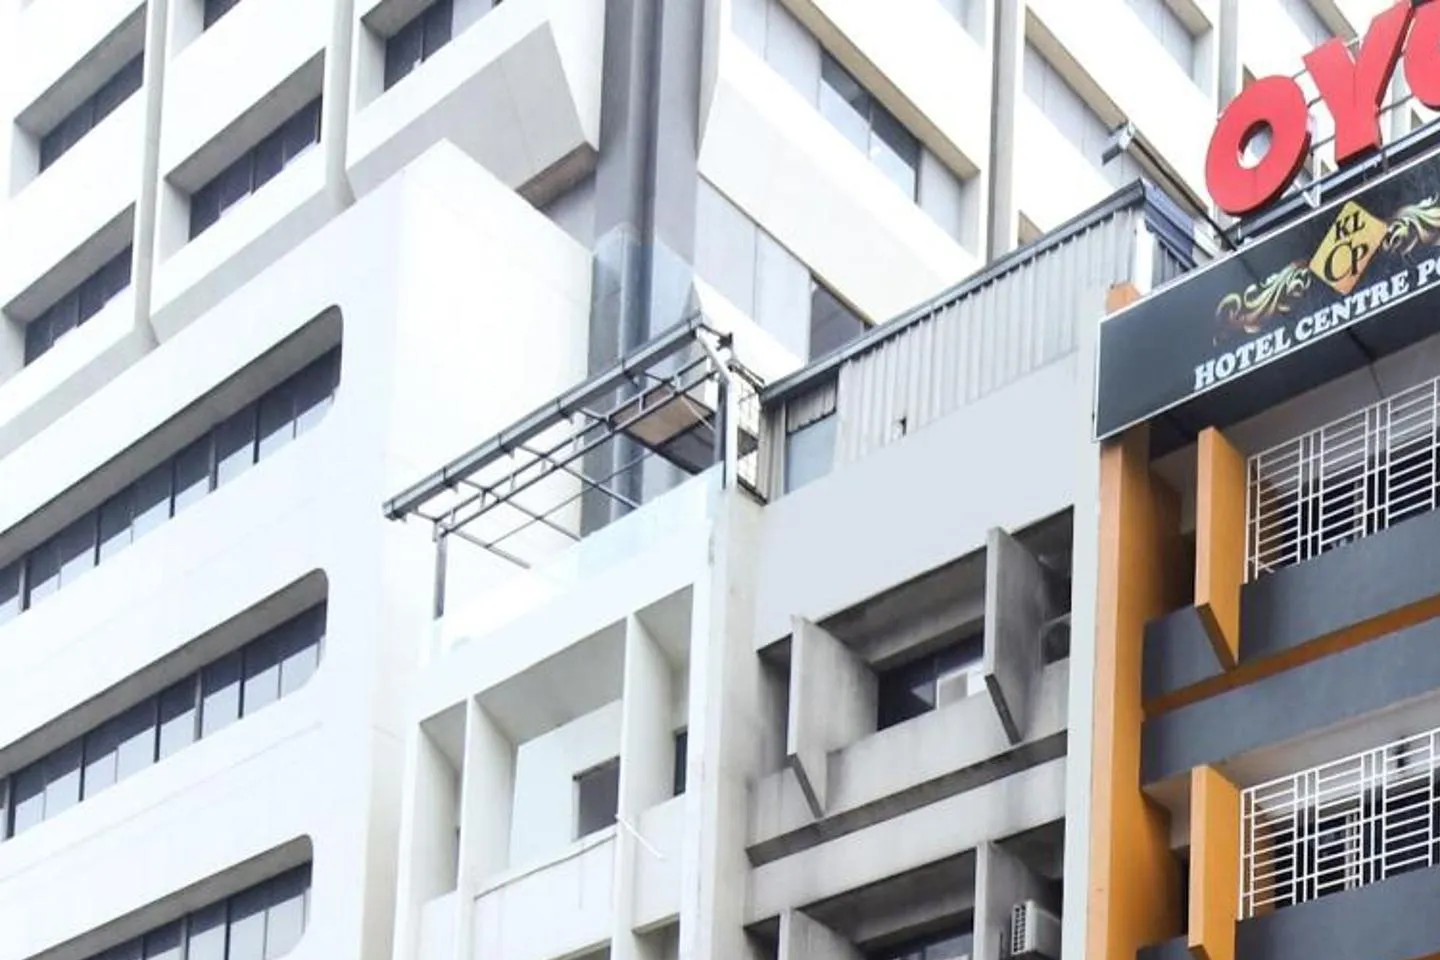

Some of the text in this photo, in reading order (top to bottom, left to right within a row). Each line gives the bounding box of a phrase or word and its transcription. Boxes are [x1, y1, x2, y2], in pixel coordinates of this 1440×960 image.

[1333, 211, 1366, 243] KL
[1323, 238, 1369, 283] CP
[1193, 326, 1291, 391] HOTEL
[1294, 269, 1410, 342] CENTRE
